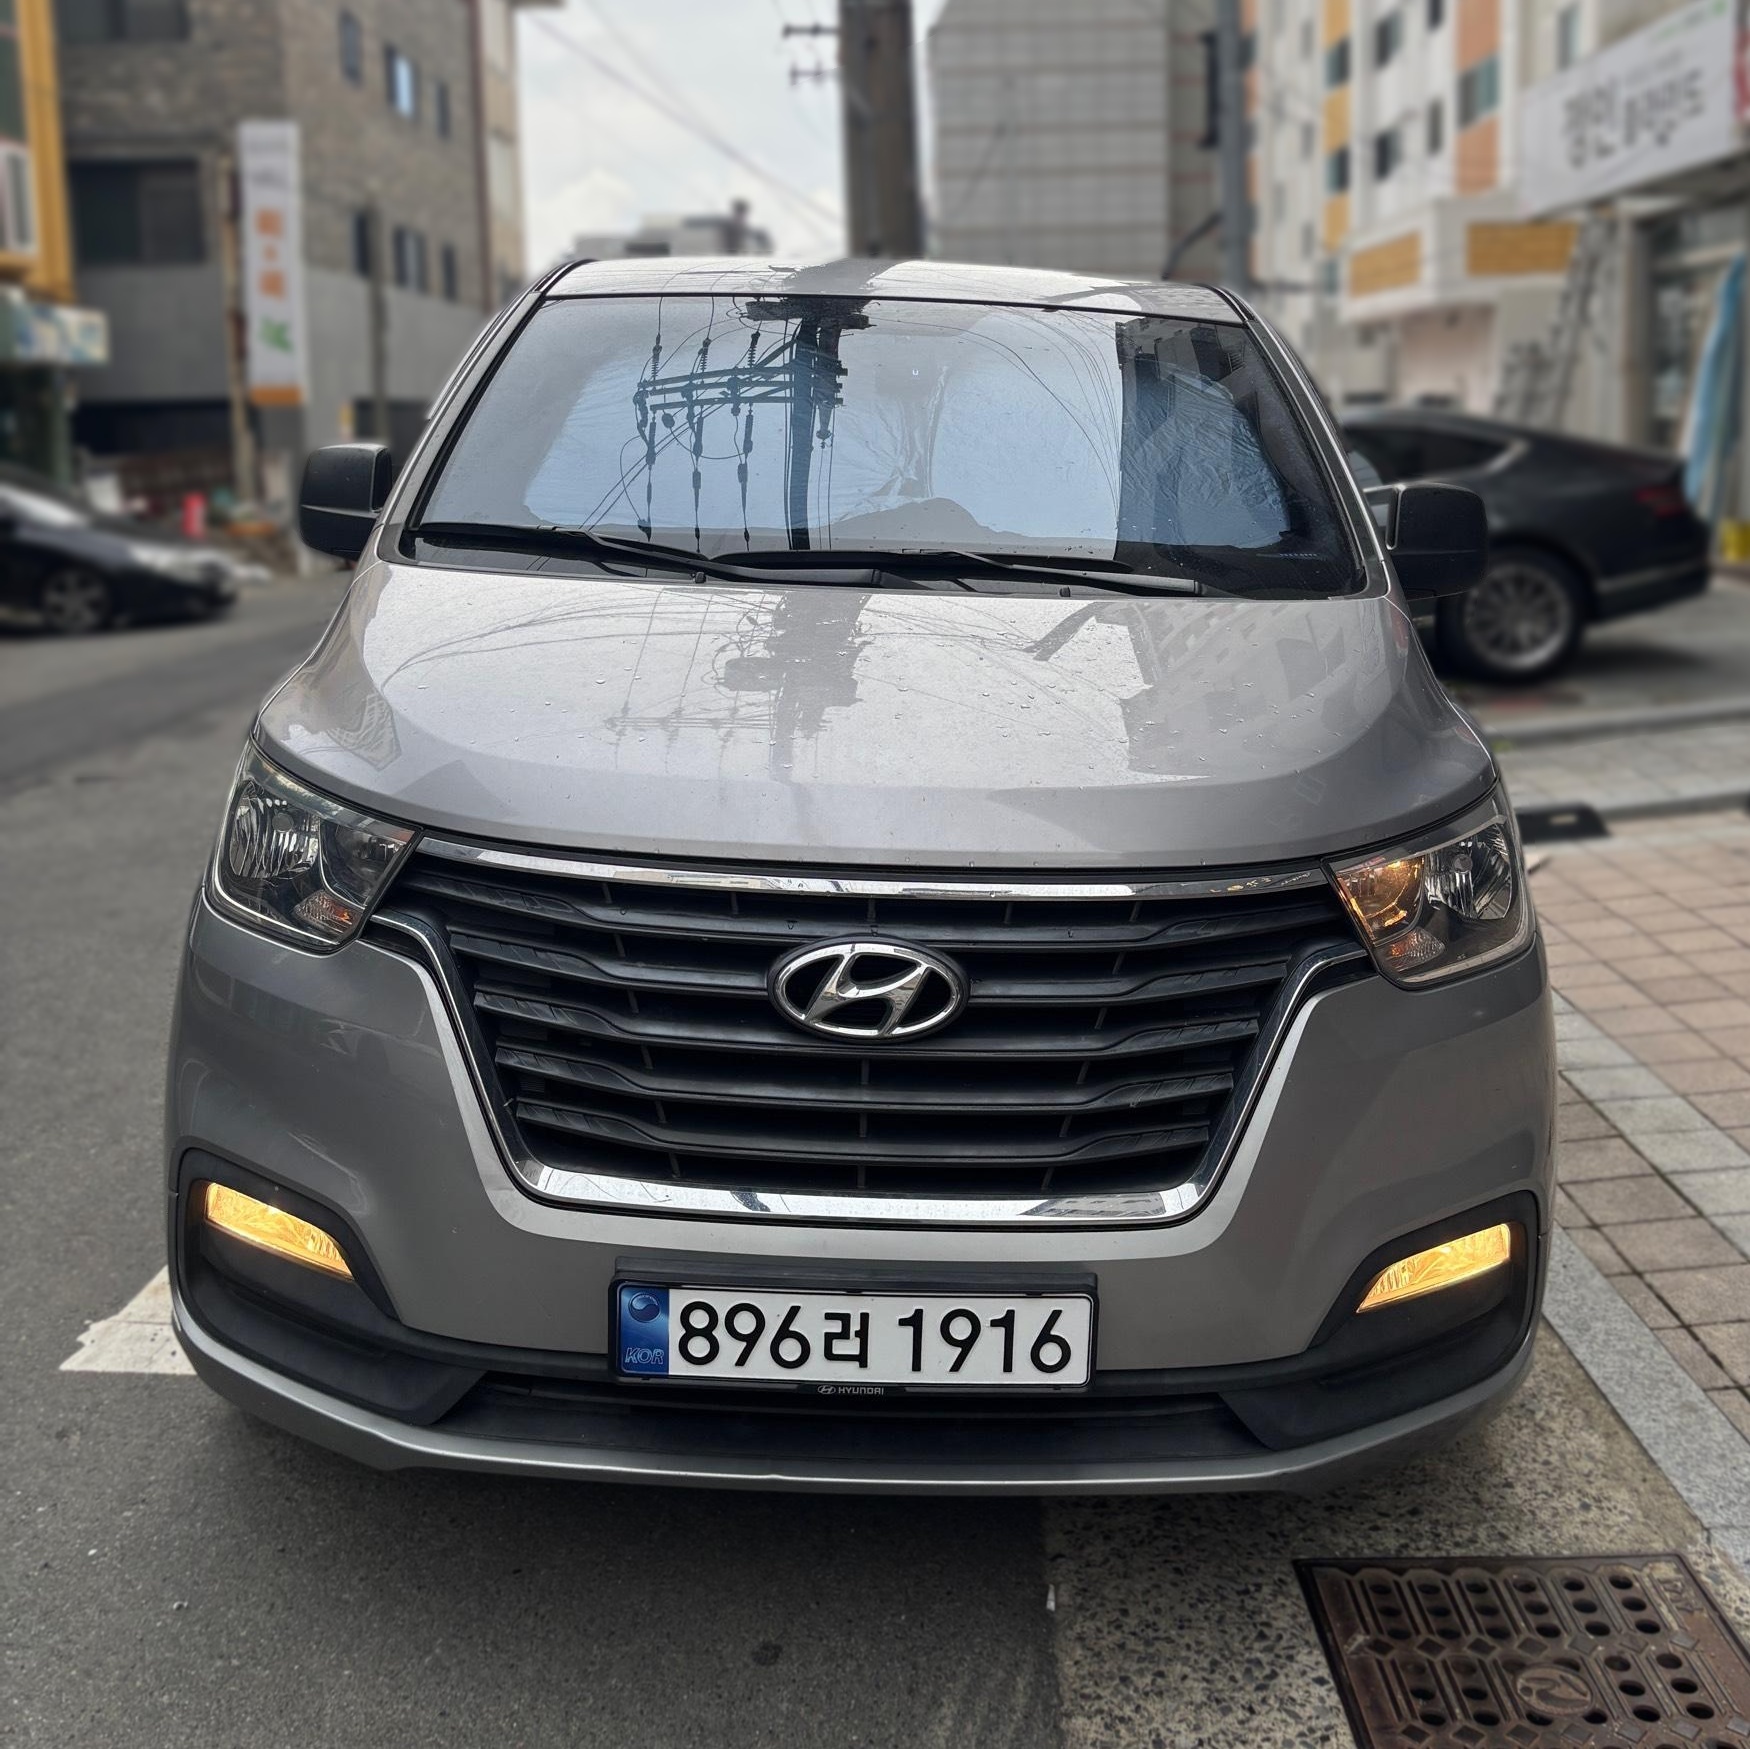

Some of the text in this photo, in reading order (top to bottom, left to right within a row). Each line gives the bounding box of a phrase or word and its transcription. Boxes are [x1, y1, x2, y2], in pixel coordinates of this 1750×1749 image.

[678, 1300, 1072, 1374] 896러 1916
[624, 1347, 665, 1365] KOR
[838, 1386, 884, 1396] HYUNDAI
